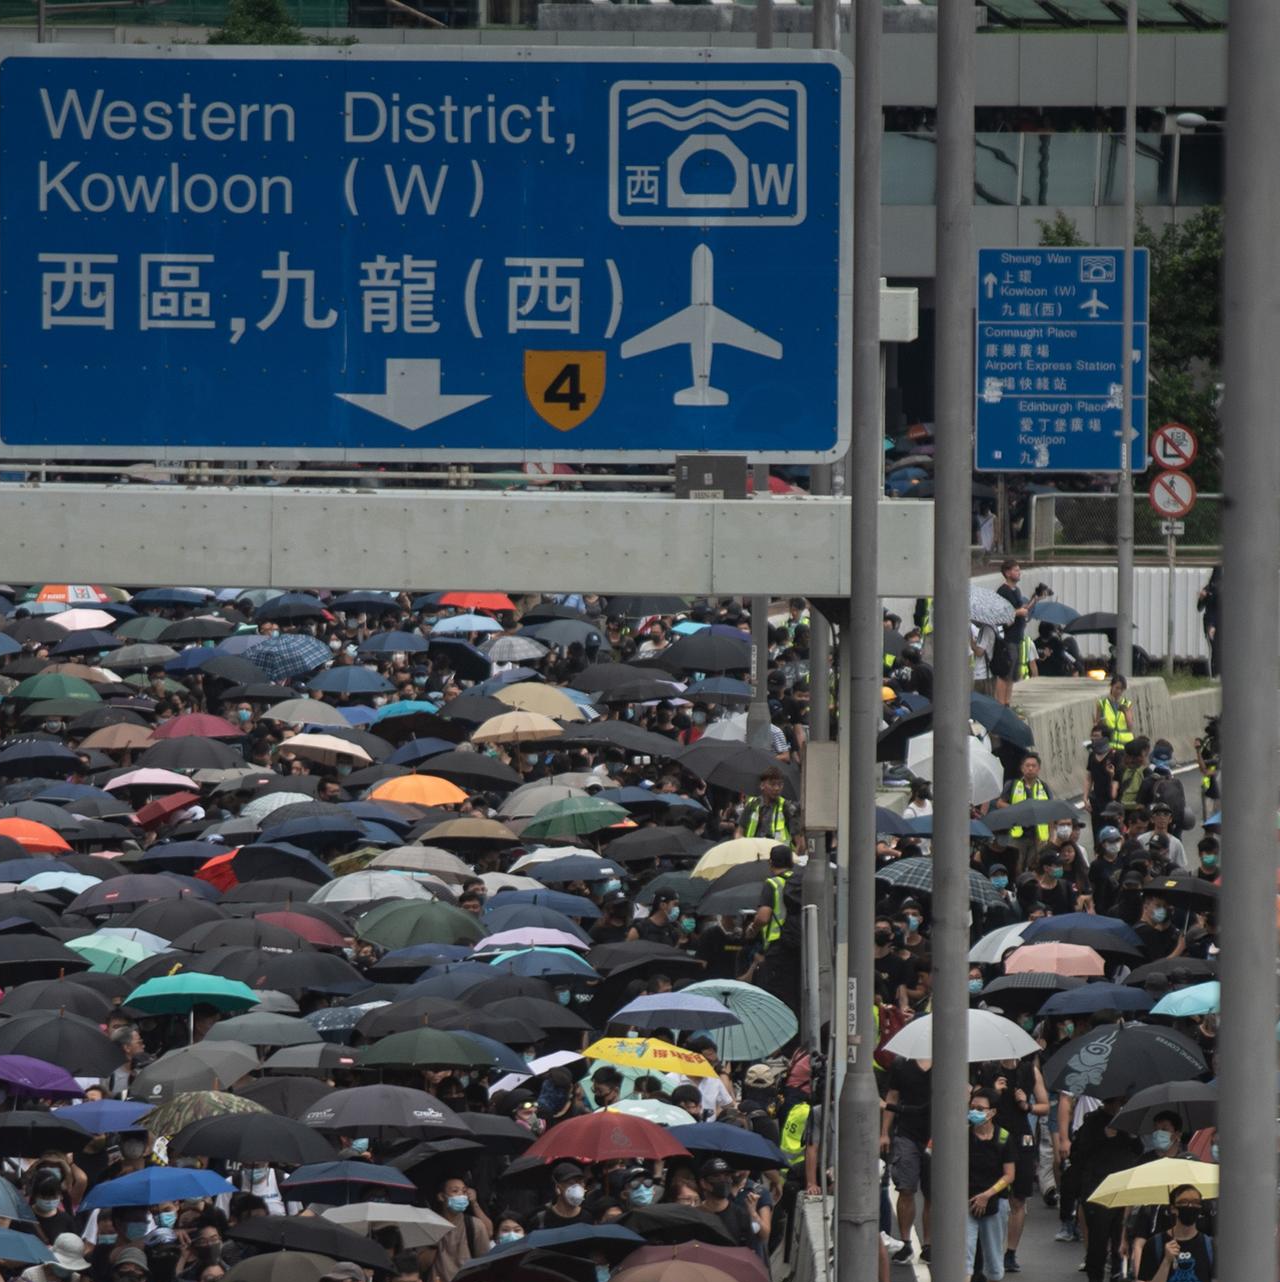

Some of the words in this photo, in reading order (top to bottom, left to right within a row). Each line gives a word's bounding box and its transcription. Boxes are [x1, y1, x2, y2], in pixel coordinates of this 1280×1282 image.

[39, 88, 297, 142] Western
[343, 91, 577, 155] District,
[38, 160, 293, 215] Kowloon
[625, 165, 660, 206] 西
[751, 163, 795, 206] W
[1001, 253, 1041, 265] Sheung
[1048, 253, 1071, 263] Wan
[1002, 270, 1032, 284] 上環
[1000, 285, 1047, 297] Kowloon
[1054, 285, 1076, 297] (W)
[985, 327, 1044, 340] Connaught
[1047, 327, 1077, 338] Place
[985, 361, 1022, 372] Airport
[1026, 361, 1072, 372] Express
[1076, 360, 1116, 371] Station
[542, 363, 587, 412] 4
[1019, 401, 1073, 413] Edinburgh
[1019, 434, 1066, 446] Kowloon
[848, 982, 856, 1033] 31837
[848, 1047, 856, 1063] A
